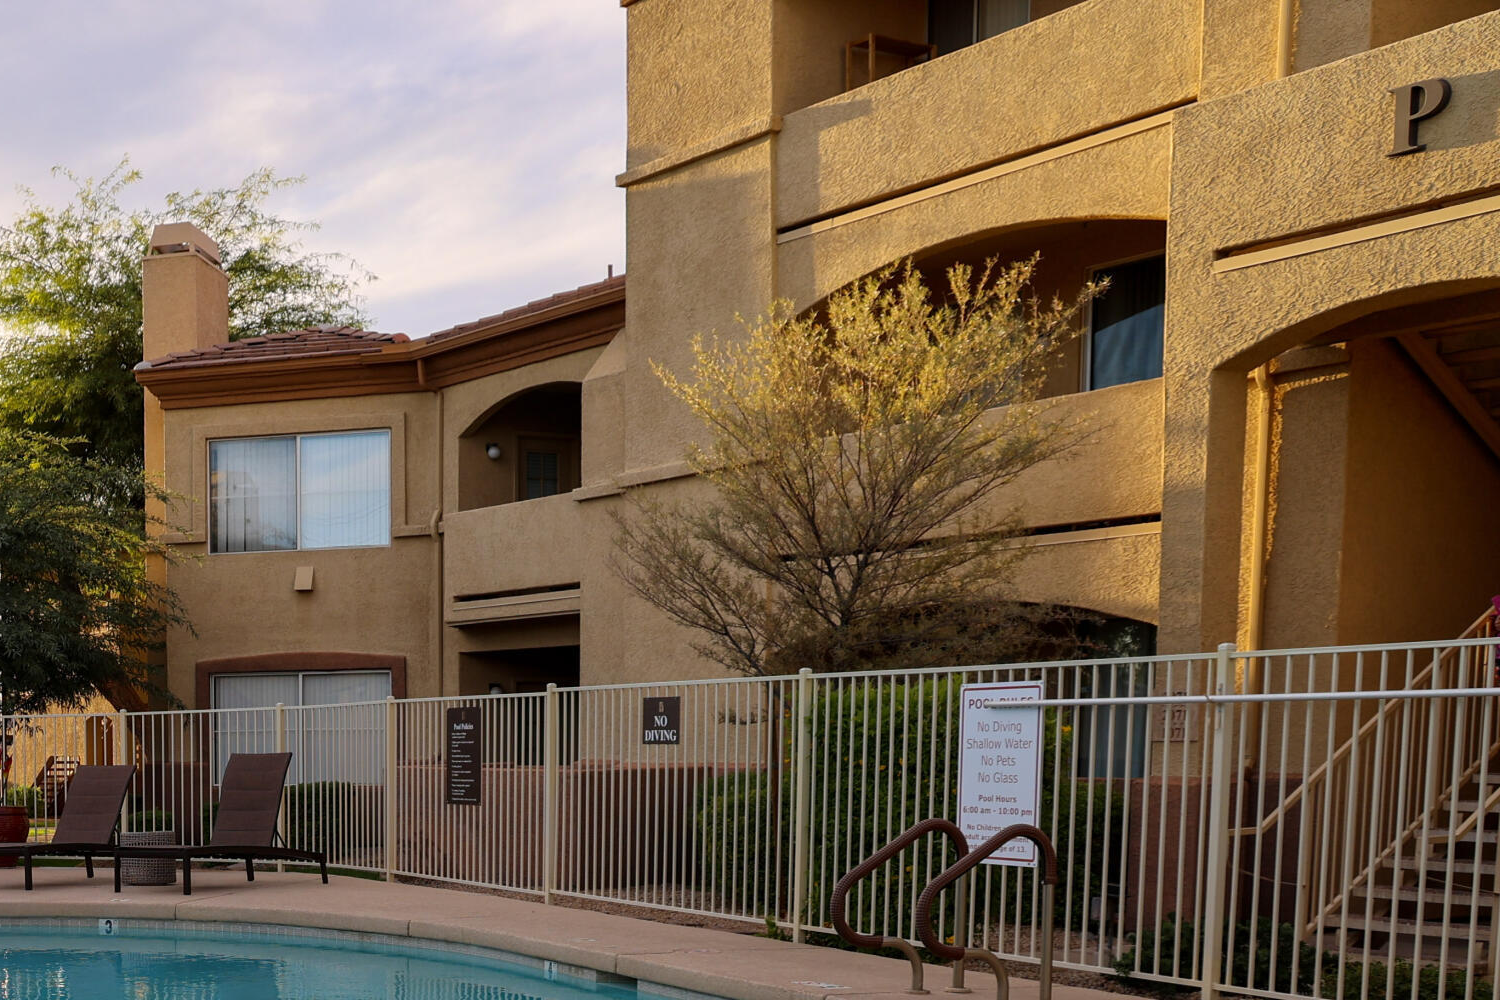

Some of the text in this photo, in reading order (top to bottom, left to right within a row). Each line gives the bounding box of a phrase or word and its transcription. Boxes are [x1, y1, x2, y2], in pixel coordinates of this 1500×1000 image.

[1386, 78, 1452, 159] P
[654, 715, 668, 727] NO
[977, 720, 1022, 735] No Diving
[644, 729, 677, 741] DIVING
[966, 738, 1033, 750] Shallow Water
[981, 754, 1016, 766] No Pets
[978, 771, 1019, 784] No Glass
[978, 794, 1017, 803] Pool Hours
[963, 805, 978, 814] 6:00
[998, 807, 1019, 816] 10:00
[1021, 809, 1033, 817] pm
[967, 823, 975, 831] No
